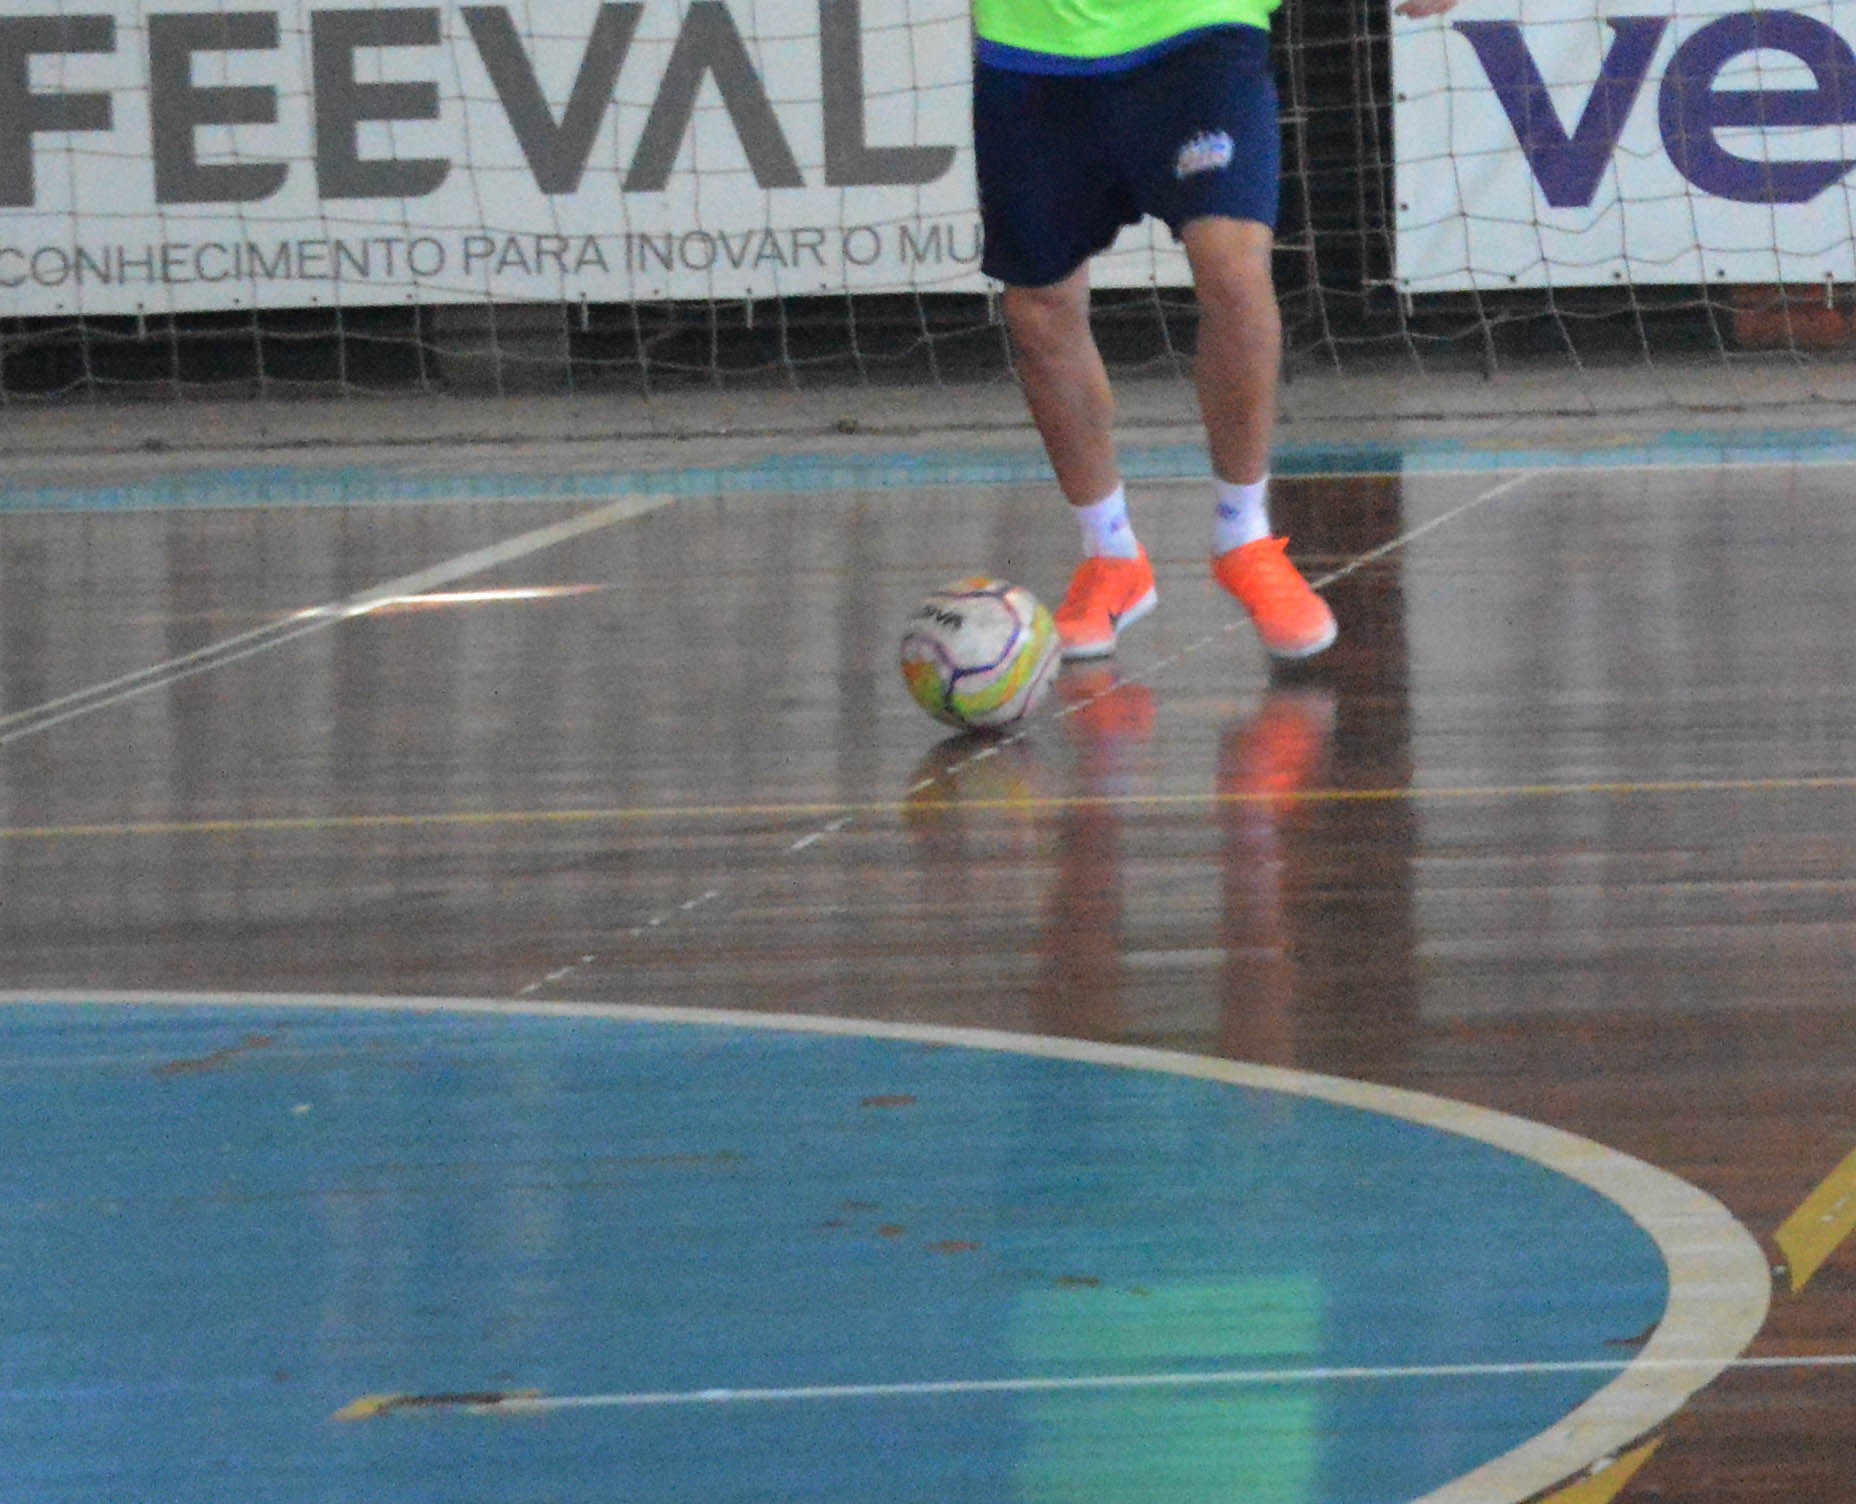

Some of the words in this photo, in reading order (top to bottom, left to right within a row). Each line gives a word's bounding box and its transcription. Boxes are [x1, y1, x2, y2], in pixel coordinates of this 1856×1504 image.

[0, 238, 446, 288] CONHECIMENTO
[462, 233, 608, 277] PARA
[626, 227, 825, 273] INOVAR
[843, 226, 881, 266] O
[900, 223, 984, 265] MU
